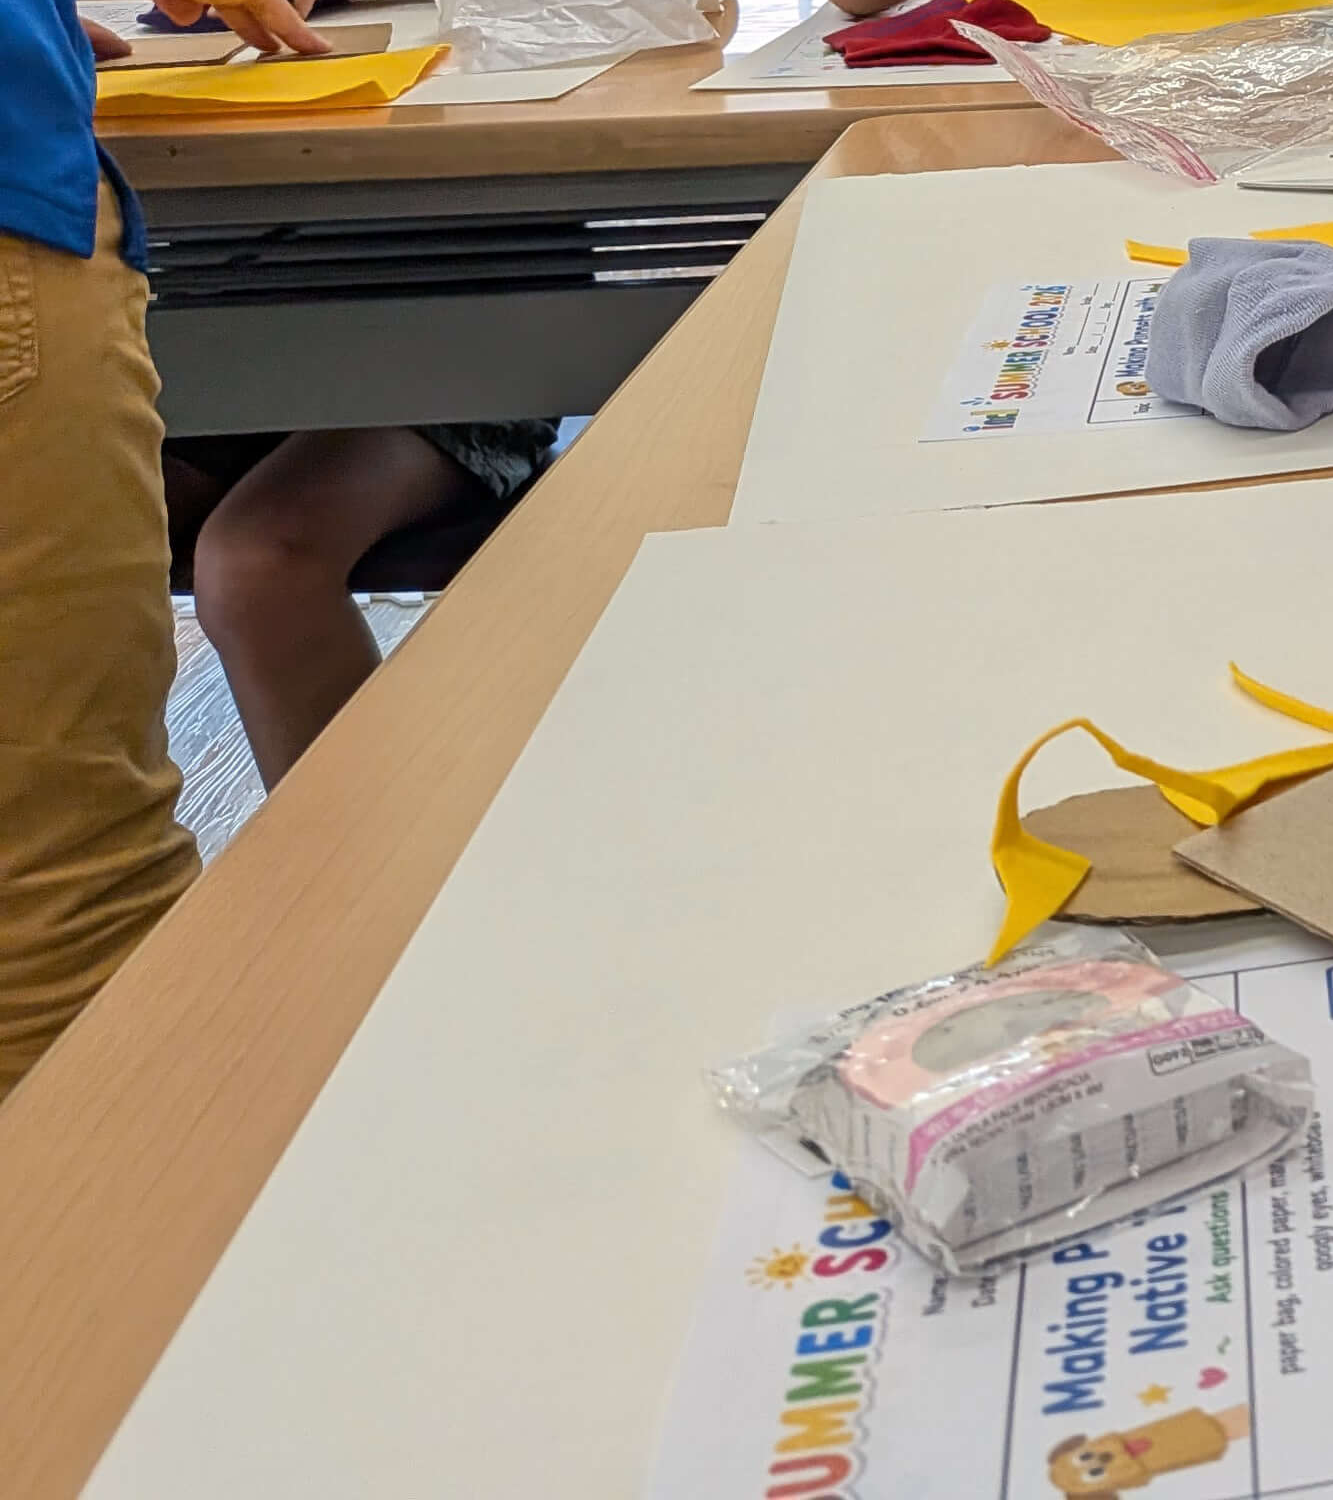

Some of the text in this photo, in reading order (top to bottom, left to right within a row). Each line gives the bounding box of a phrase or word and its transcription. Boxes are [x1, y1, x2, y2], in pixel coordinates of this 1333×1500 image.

[1012, 307, 1060, 348] SCHOOL
[990, 350, 1043, 400] SUMMER
[1206, 1189, 1240, 1304] Ask questions
[1267, 1238, 1294, 1289] colored
[1128, 1233, 1188, 1355] Native
[1042, 1271, 1125, 1415] Making
[1279, 1331, 1306, 1375] paper
[764, 1292, 881, 1500] UMMER
